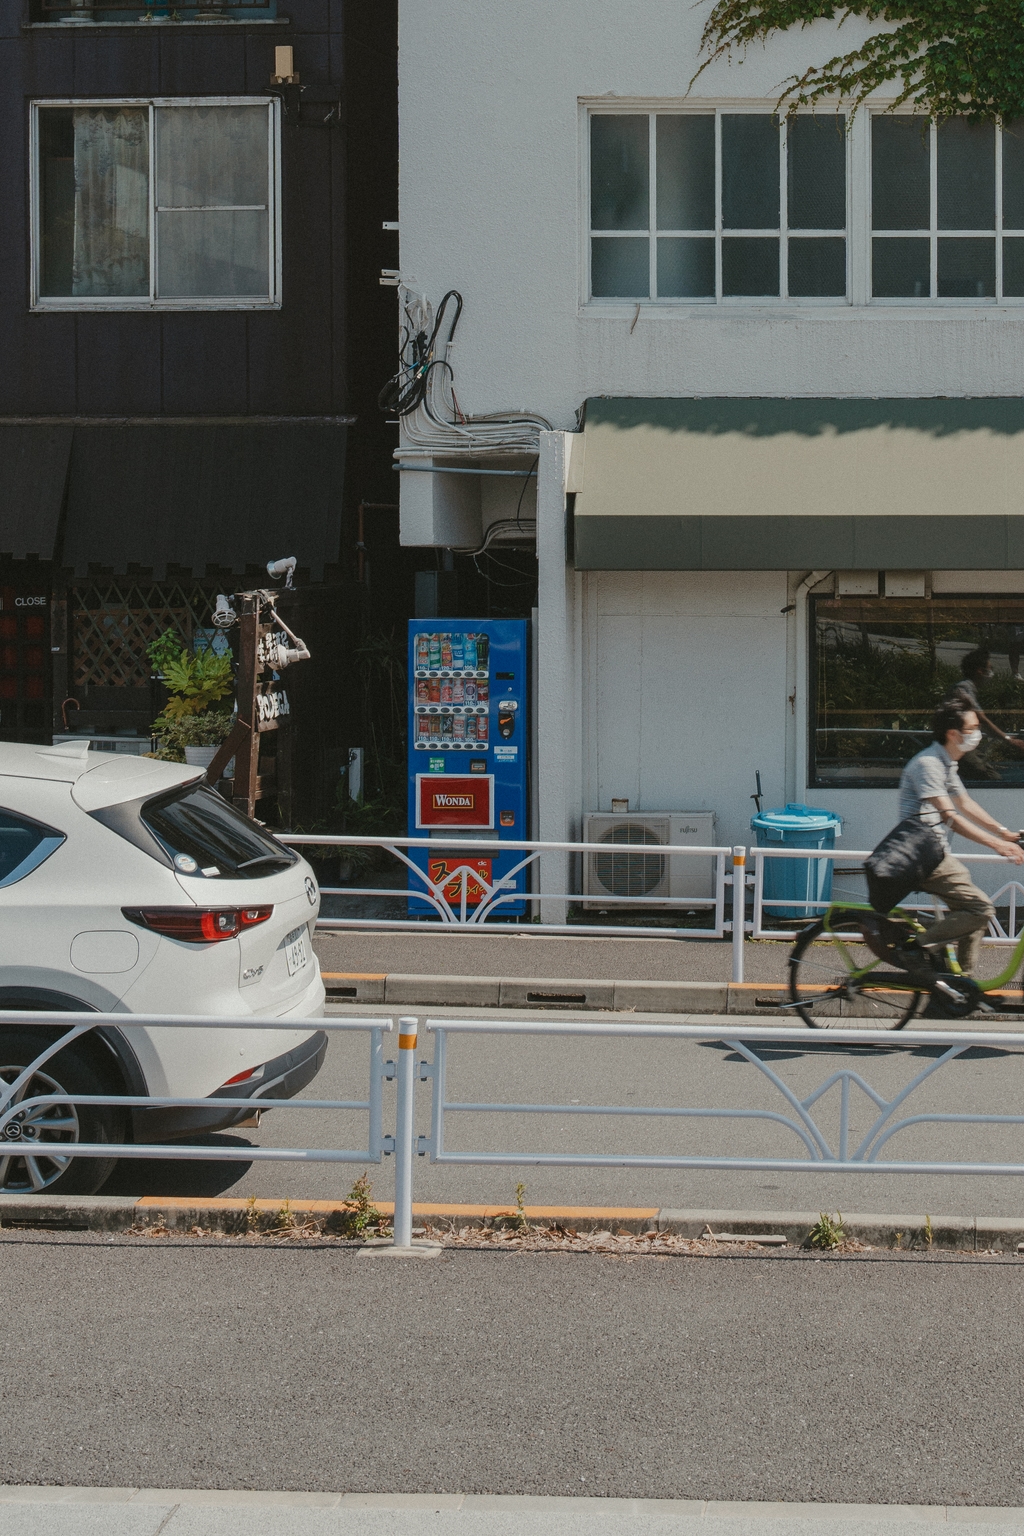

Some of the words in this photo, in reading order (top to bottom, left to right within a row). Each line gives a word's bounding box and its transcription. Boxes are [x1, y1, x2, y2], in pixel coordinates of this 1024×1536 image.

[15, 596, 46, 606] CLOSE
[256, 690, 290, 721] BODEGA
[435, 794, 471, 806] WONDA
